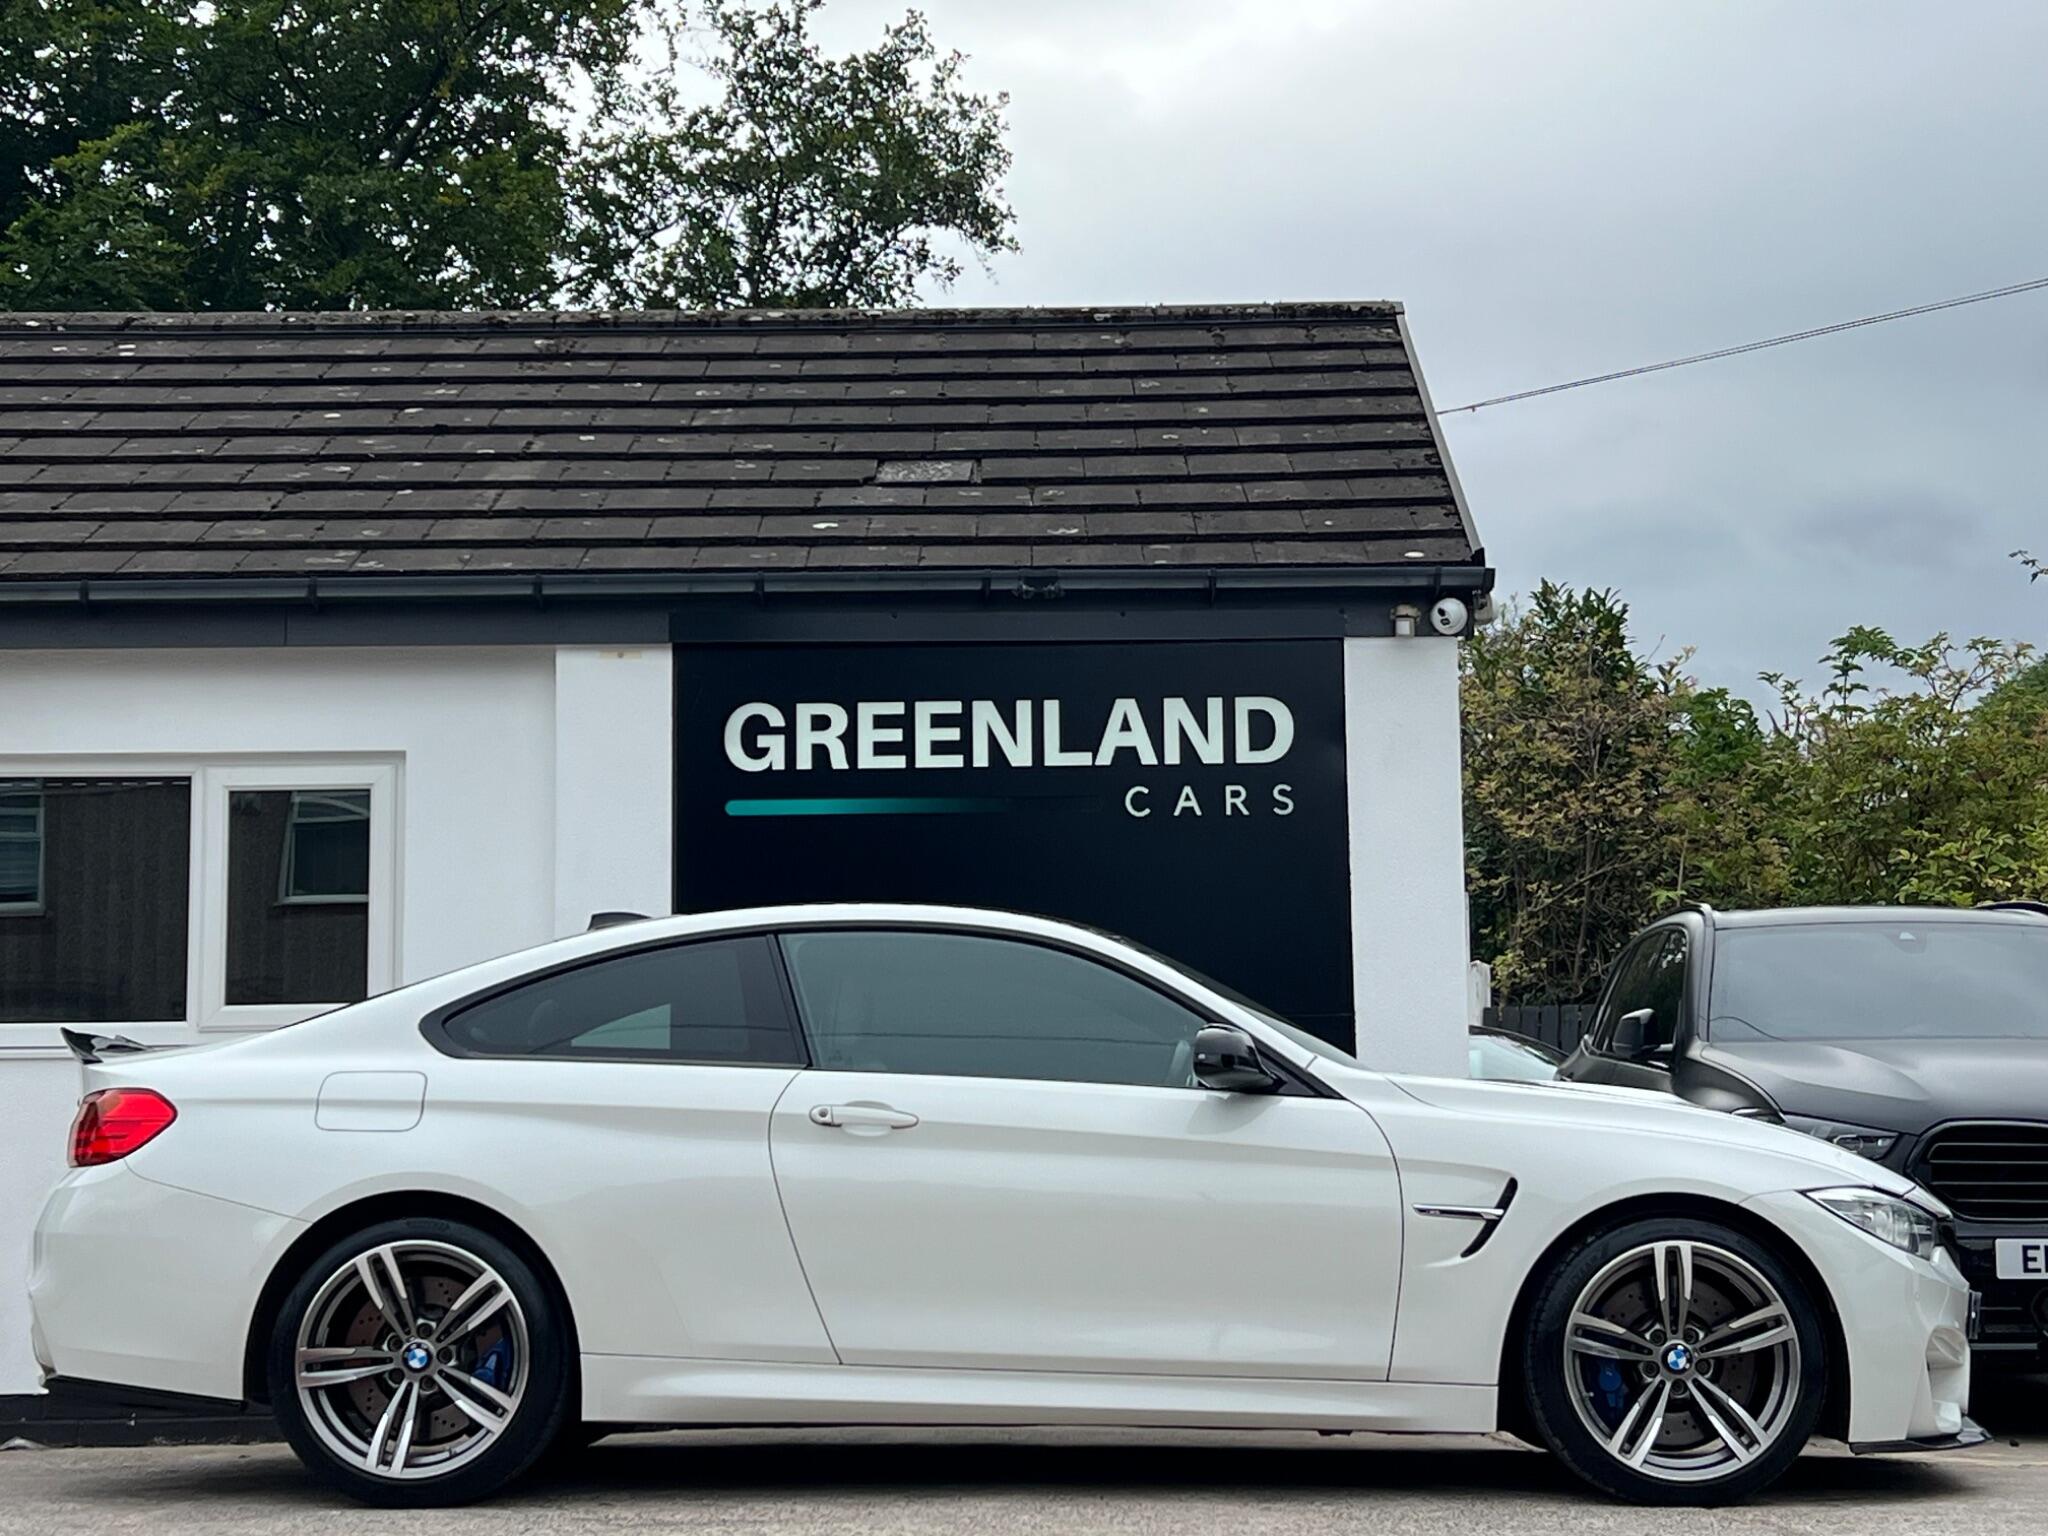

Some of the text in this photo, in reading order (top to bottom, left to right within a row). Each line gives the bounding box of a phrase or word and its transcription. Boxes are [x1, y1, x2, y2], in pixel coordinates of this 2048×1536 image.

[724, 696, 1295, 772] GREENLAND
[1125, 783, 1294, 817] CARS
[2022, 1245, 2048, 1273] E
